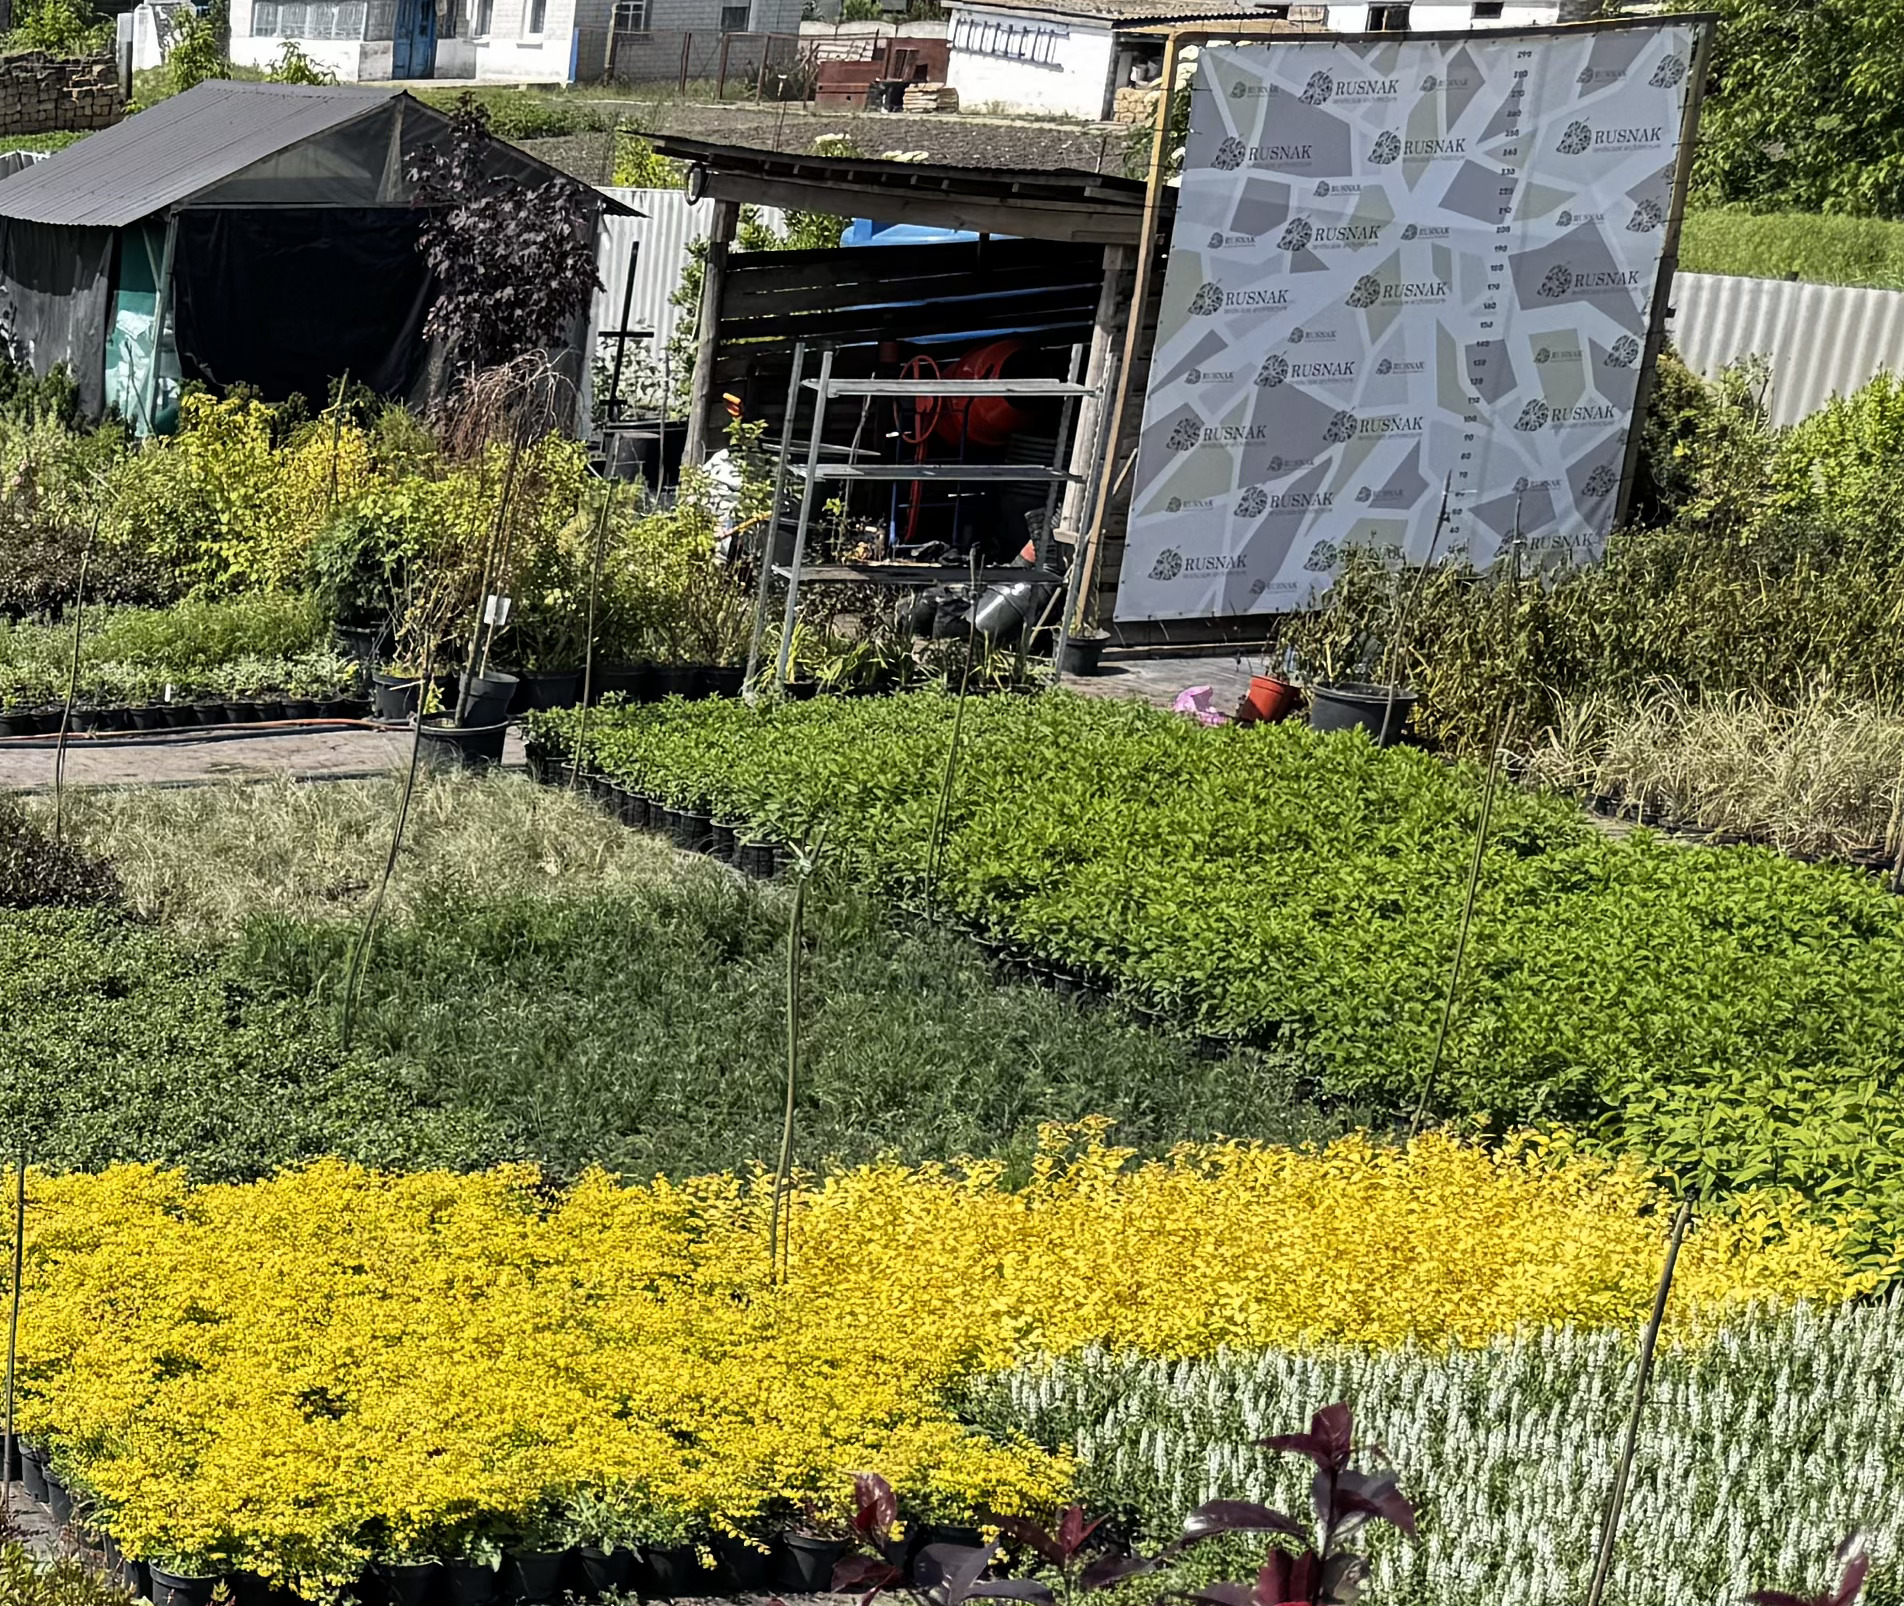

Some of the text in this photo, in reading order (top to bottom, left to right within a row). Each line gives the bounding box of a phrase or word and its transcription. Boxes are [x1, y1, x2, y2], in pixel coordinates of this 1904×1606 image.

[1335, 79, 1399, 96] RUSNAK
[1595, 127, 1661, 144] RUSNAK
[1248, 145, 1312, 161] RUSNAK
[1403, 138, 1466, 155] RUSNAK
[1314, 225, 1381, 242] RUSNAK
[1574, 271, 1639, 288] RUSNAK
[1225, 289, 1289, 306] RUSNAK
[1382, 281, 1447, 298] RUSNAK
[1291, 361, 1355, 378] RUSNAK
[1552, 405, 1615, 422] RUSNAK
[1203, 425, 1267, 441] RUSNAK
[1359, 416, 1423, 433] RUSNAK
[1271, 492, 1334, 509] RUSNAK
[1530, 533, 1593, 550] RUSNAK
[1185, 554, 1247, 571] RUSNAK
